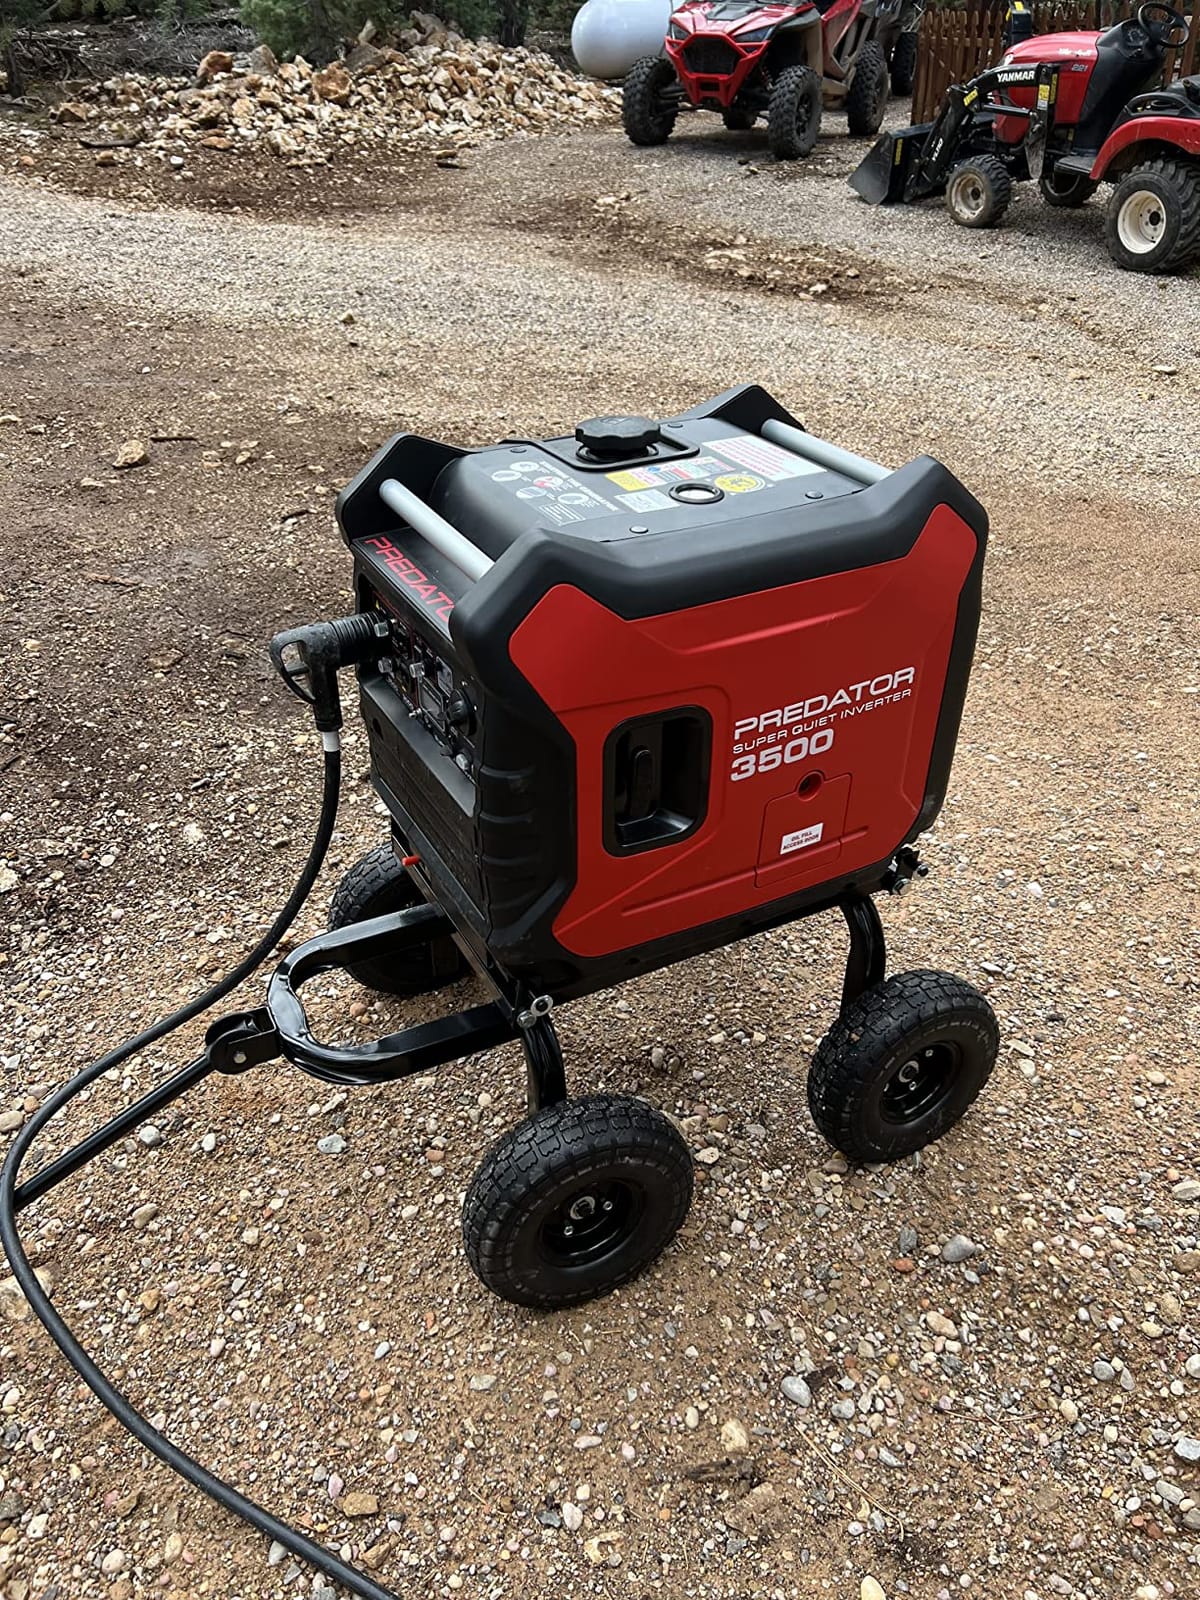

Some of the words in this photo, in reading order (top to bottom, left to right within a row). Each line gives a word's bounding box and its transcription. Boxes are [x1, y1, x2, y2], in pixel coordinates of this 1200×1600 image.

[997, 70, 1035, 82] YANMAR
[733, 666, 916, 741] PREDATOR
[732, 729, 788, 755] SUPER
[791, 713, 837, 735] QUIET
[840, 688, 912, 720] INVERTER
[730, 728, 834, 782] 3500
[782, 839, 804, 850] ACCESS
[804, 833, 820, 843] DOOR
[791, 834, 801, 842] OIL
[801, 830, 813, 838] FILL
